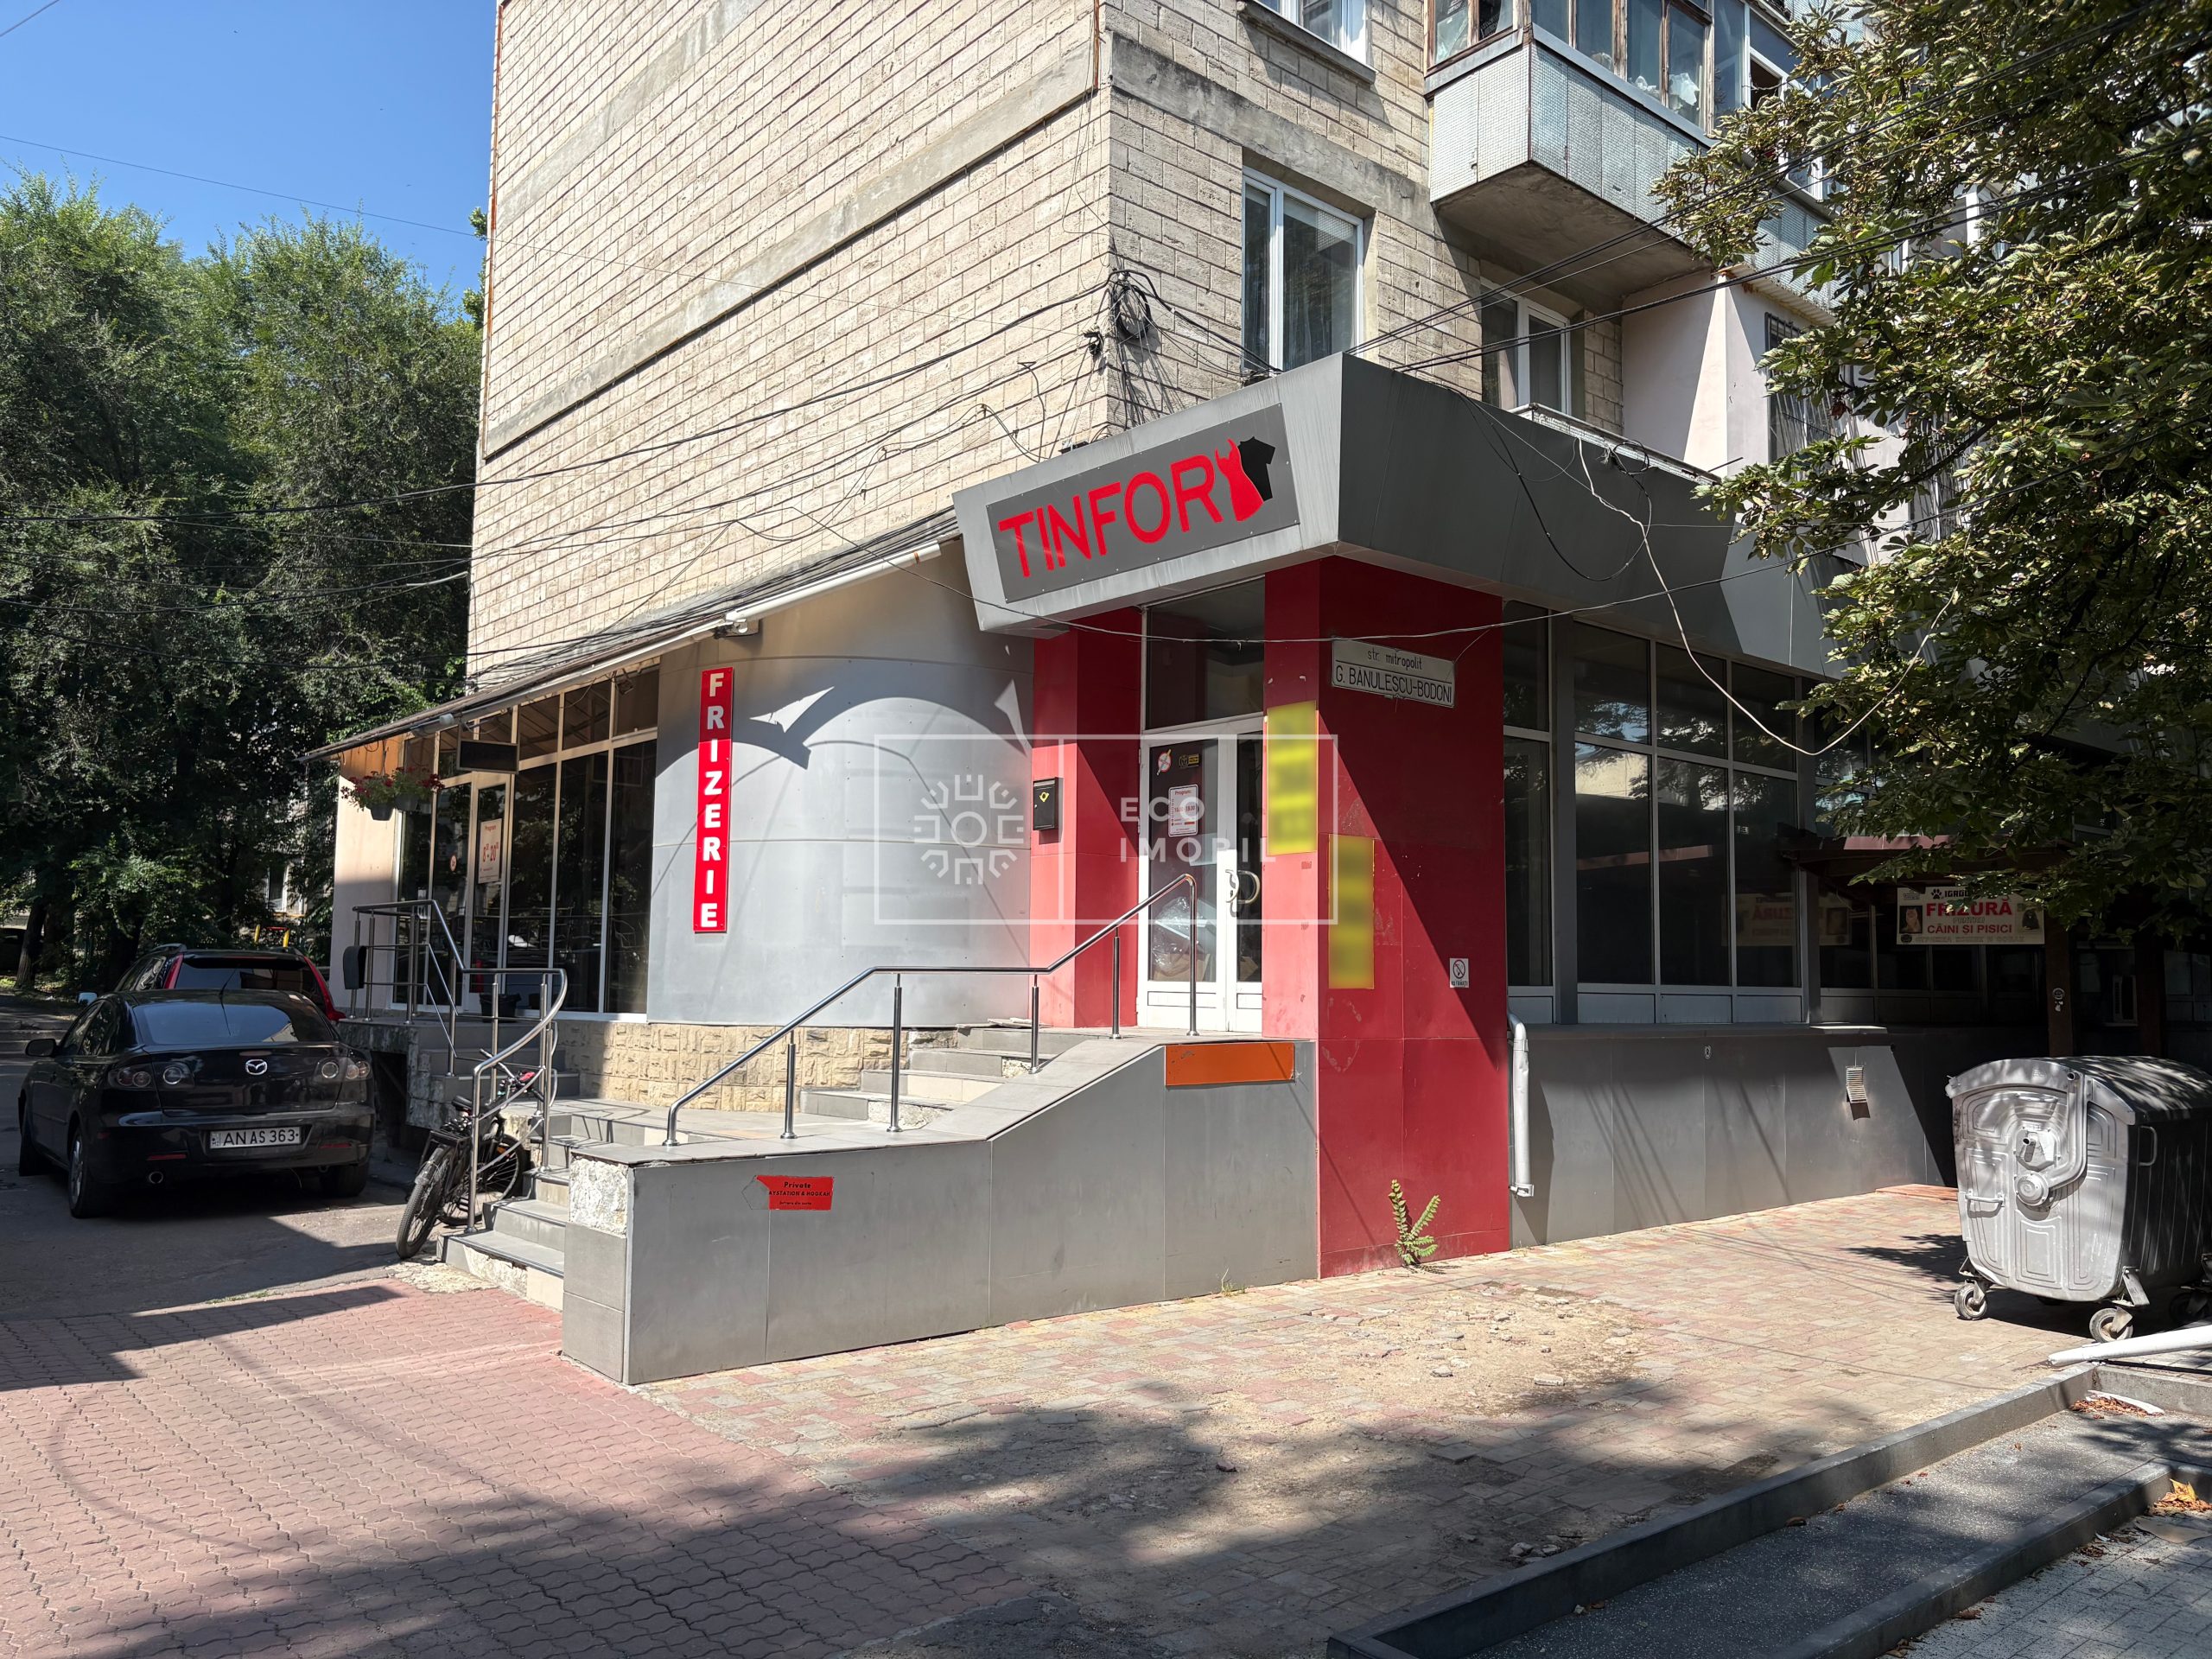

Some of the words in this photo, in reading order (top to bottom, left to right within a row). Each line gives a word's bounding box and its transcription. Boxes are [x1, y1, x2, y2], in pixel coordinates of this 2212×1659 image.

[1386, 652, 1423, 671] mitropolit
[1336, 664, 1345, 683] G.
[700, 672, 725, 928] FRIZERIE
[1977, 924, 2012, 933] PISICI
[269, 1128, 296, 1143] 363
